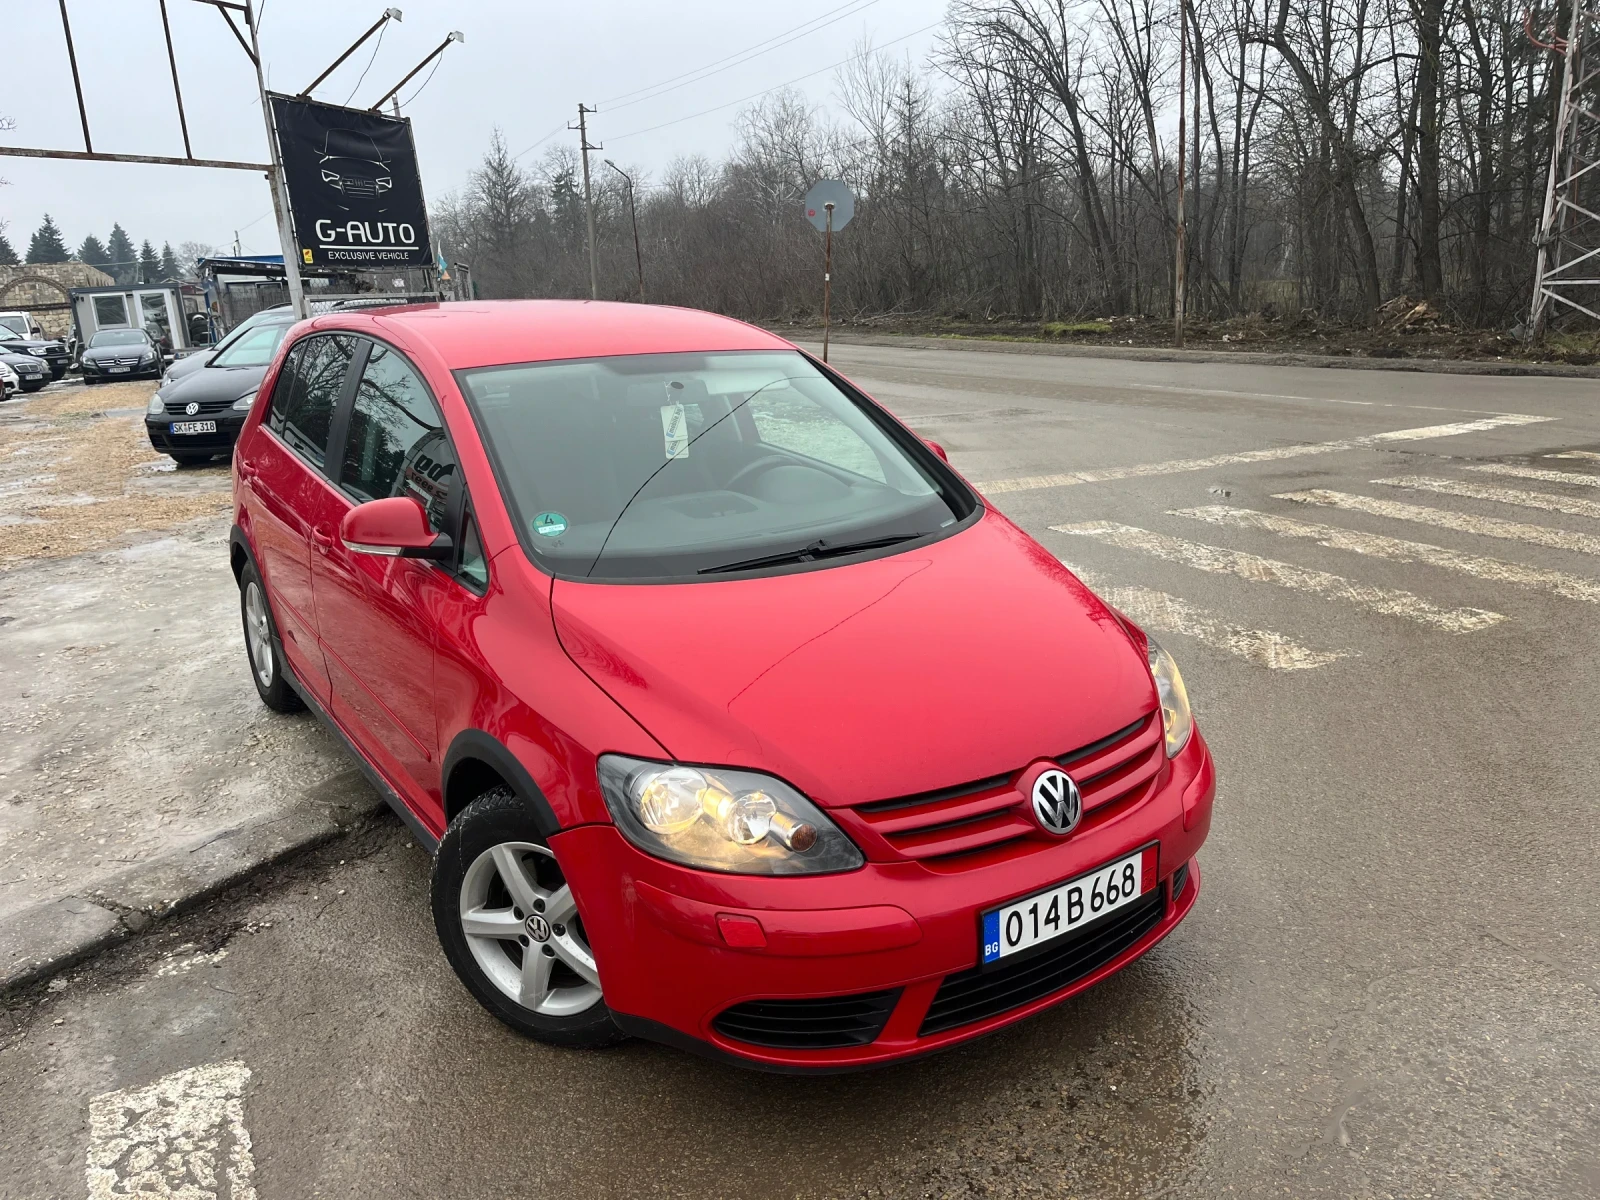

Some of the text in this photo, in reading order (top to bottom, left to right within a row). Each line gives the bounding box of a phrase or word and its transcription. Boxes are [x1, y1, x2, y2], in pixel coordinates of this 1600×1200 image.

[315, 219, 415, 244] G-AUTO
[328, 251, 410, 260] EXCLUSIVE VEHICLE
[173, 421, 215, 432] SK FE 318
[544, 514, 555, 525] 4
[984, 941, 999, 956] BG
